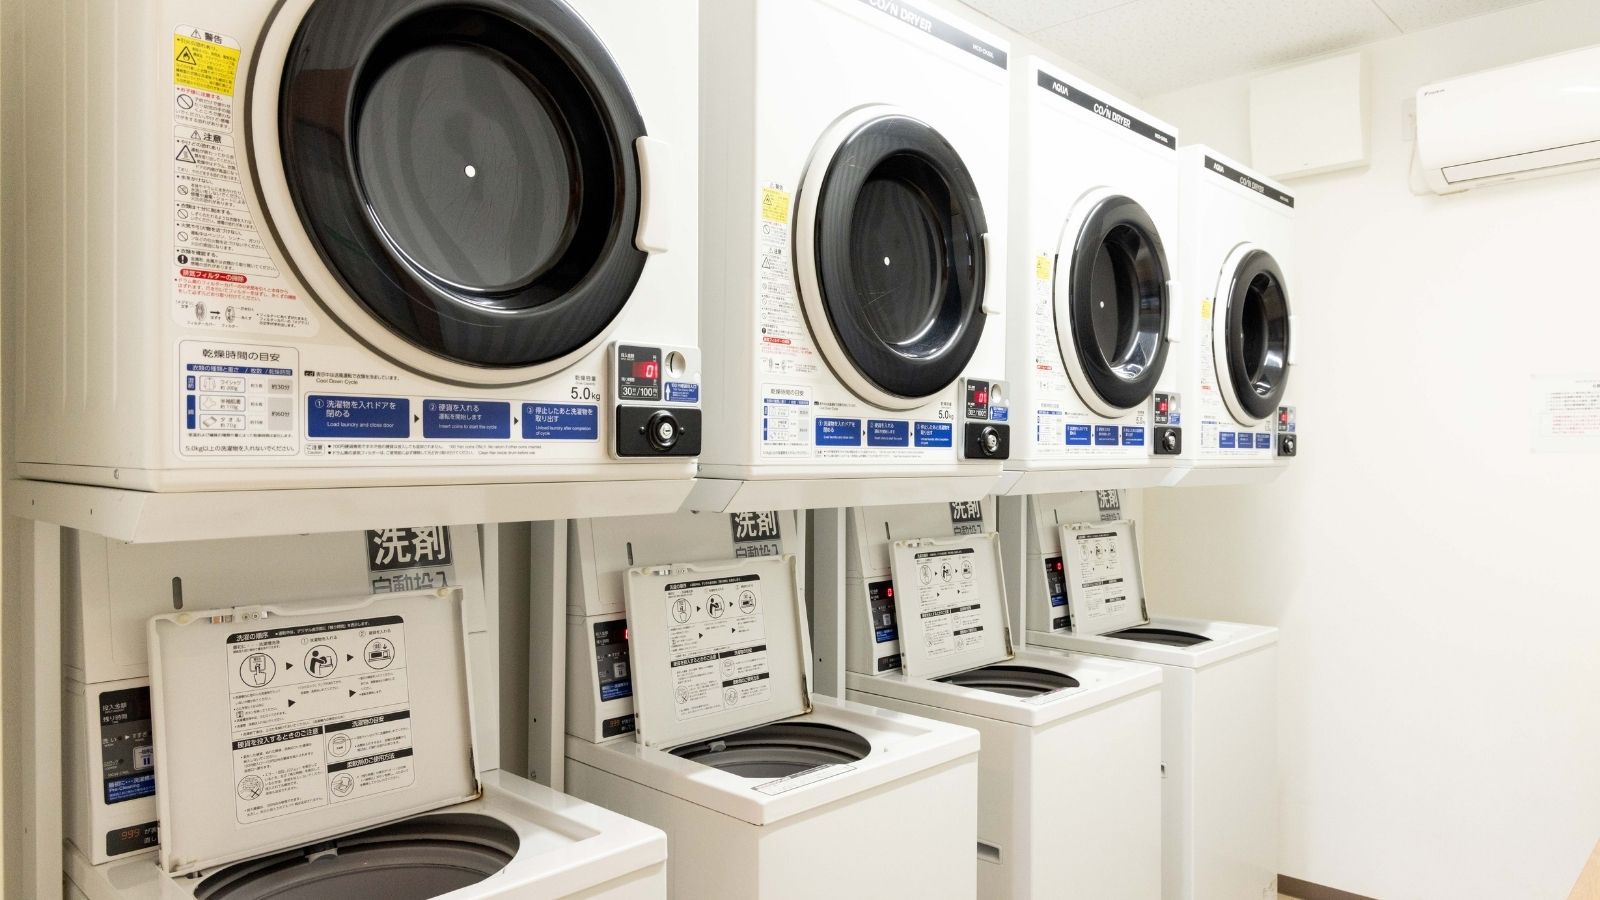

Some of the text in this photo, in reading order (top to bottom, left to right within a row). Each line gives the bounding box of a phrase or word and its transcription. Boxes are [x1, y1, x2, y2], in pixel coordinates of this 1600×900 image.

[900, 8, 932, 32] DRYER
[204, 31, 223, 45] 警告
[1052, 82, 1068, 96] AQUA
[1112, 111, 1131, 128] DRYER
[203, 132, 222, 144] 注意
[202, 349, 280, 362] 乾燥時間の目安
[570, 386, 601, 401] 5.0kg
[326, 399, 396, 410] 洗濯物を入れドアを
[438, 403, 480, 412] 硬貨を入れる
[326, 410, 351, 418] 閉める
[535, 406, 593, 416] 停止したあと洗濯物を
[438, 413, 482, 421] 運転を開始します
[535, 415, 559, 423] 取り出す
[735, 511, 777, 538] 洗剤
[373, 526, 446, 565] 洗剤
[887, 588, 892, 597] 0
[103, 702, 127, 711] 投入金額
[103, 713, 128, 722] 残り時間
[237, 728, 319, 748] 硬貨を投入するときのご注意
[109, 783, 140, 792] Pre-Cleaning
